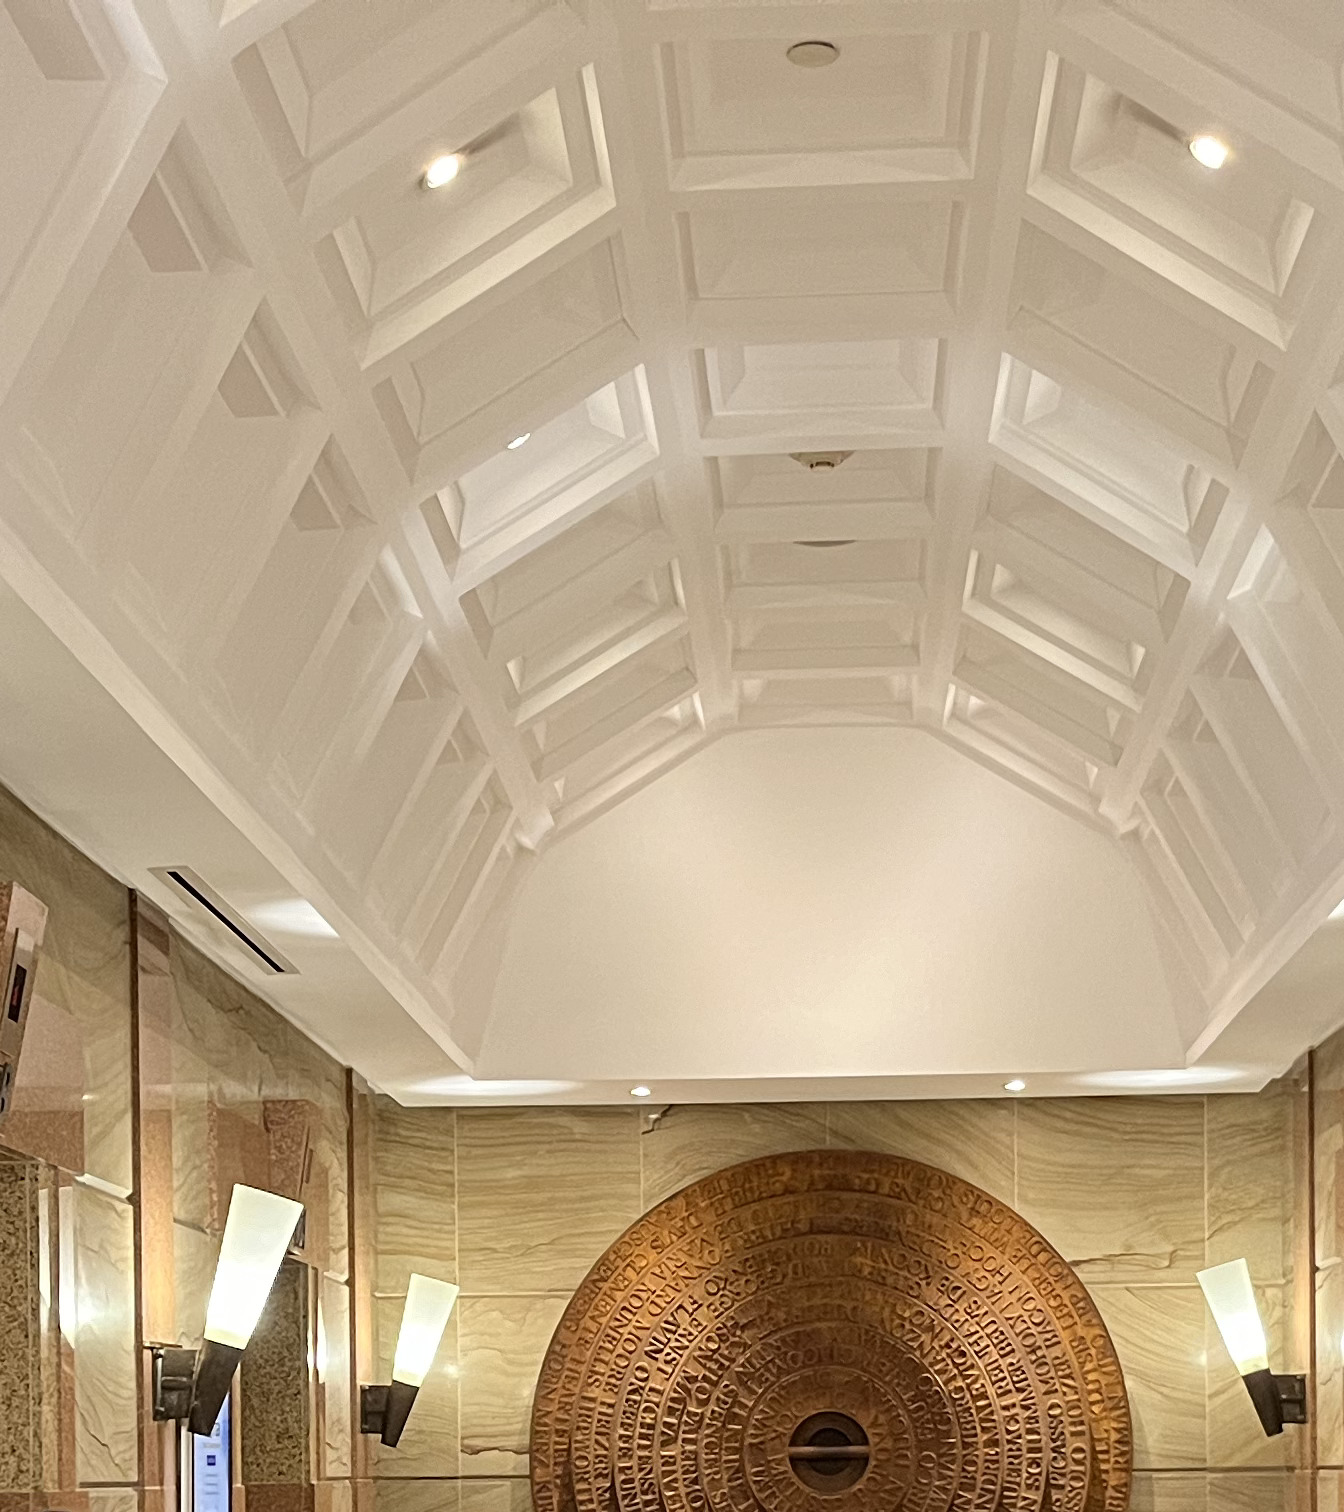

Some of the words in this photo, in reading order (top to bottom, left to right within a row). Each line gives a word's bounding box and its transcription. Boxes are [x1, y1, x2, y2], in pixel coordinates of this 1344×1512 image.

[641, 1289, 704, 1362] FLAVIN
[653, 1312, 708, 1382] ERNST
[1007, 1278, 1064, 1352] BACON
[601, 1314, 651, 1395] MOORE
[703, 1378, 740, 1481] SPENCER
[1042, 1396, 1067, 1486] PICASSO
